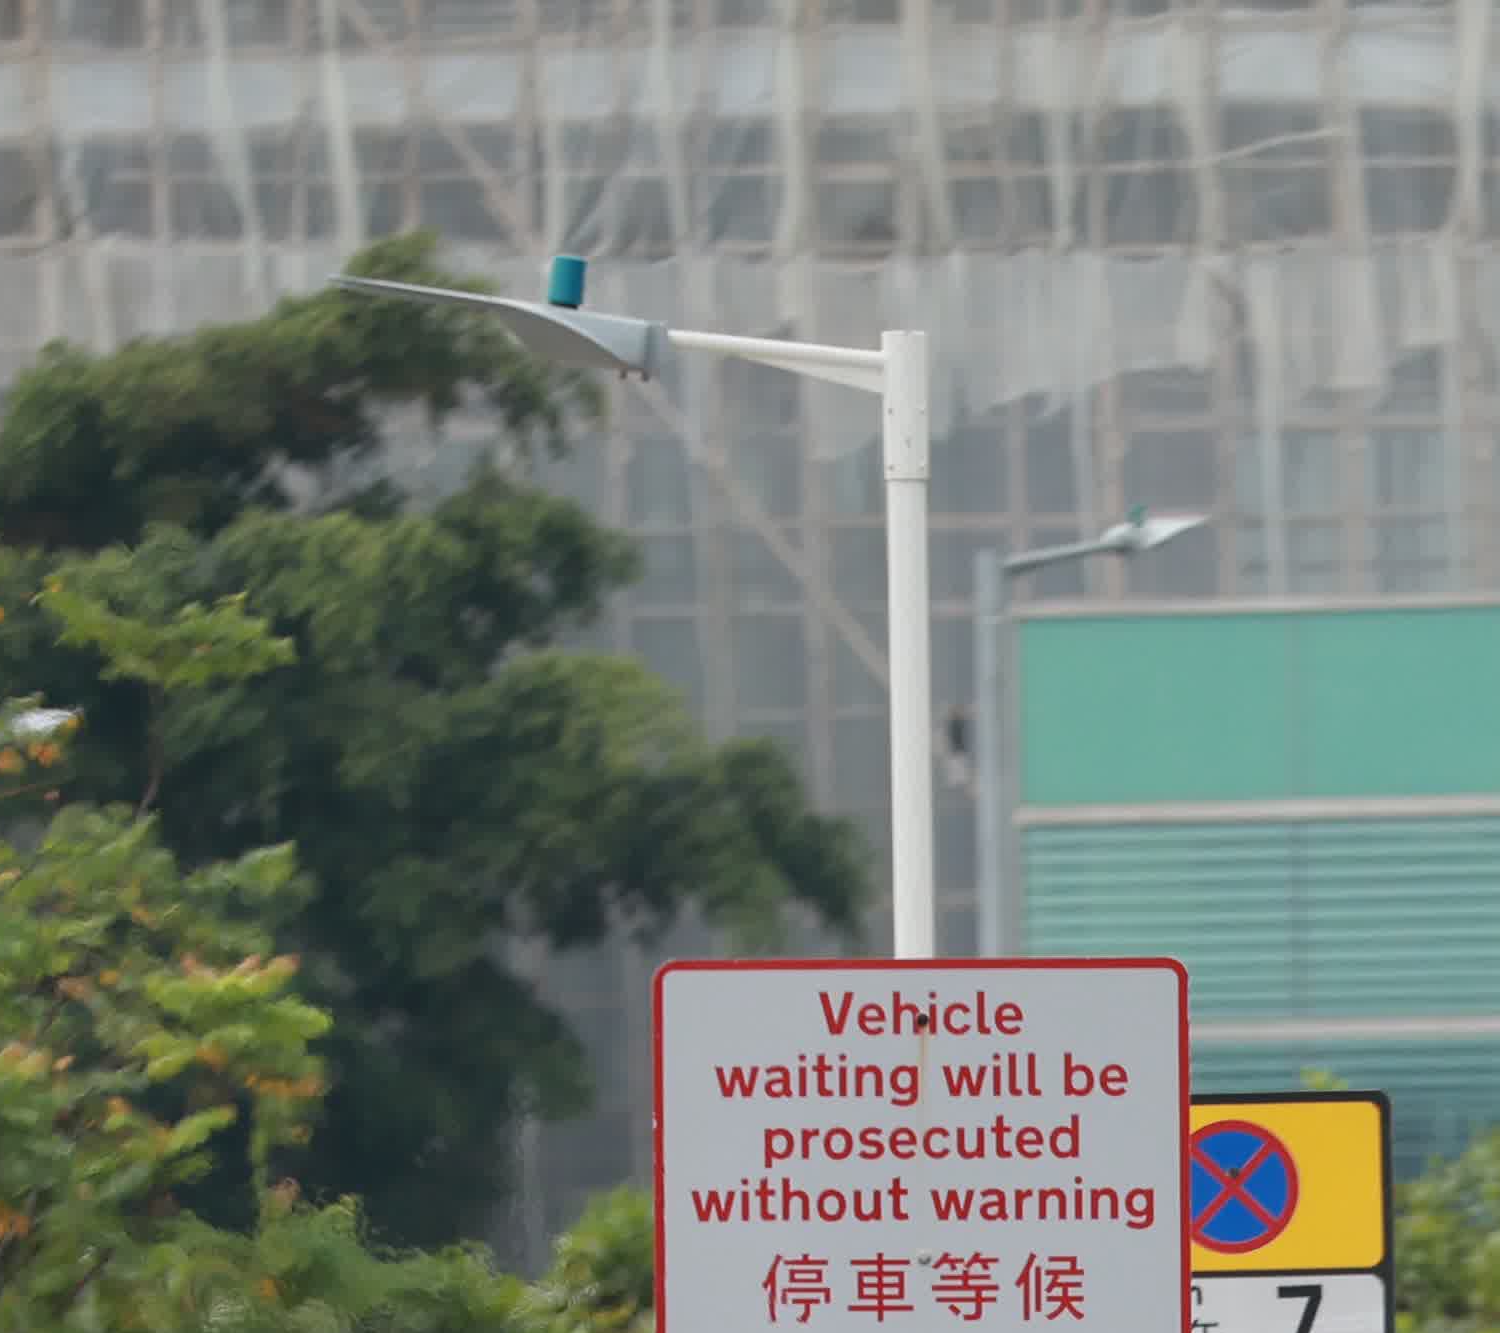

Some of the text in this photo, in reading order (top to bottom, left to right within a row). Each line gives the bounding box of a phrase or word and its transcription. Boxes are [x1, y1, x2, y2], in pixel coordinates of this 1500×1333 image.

[819, 991, 1024, 1036] Vehicle
[715, 1053, 1129, 1105] waiting will be
[764, 1114, 1080, 1168] prosecuted
[691, 1176, 1156, 1229] without warning
[762, 1252, 1085, 1322] 停車等候
